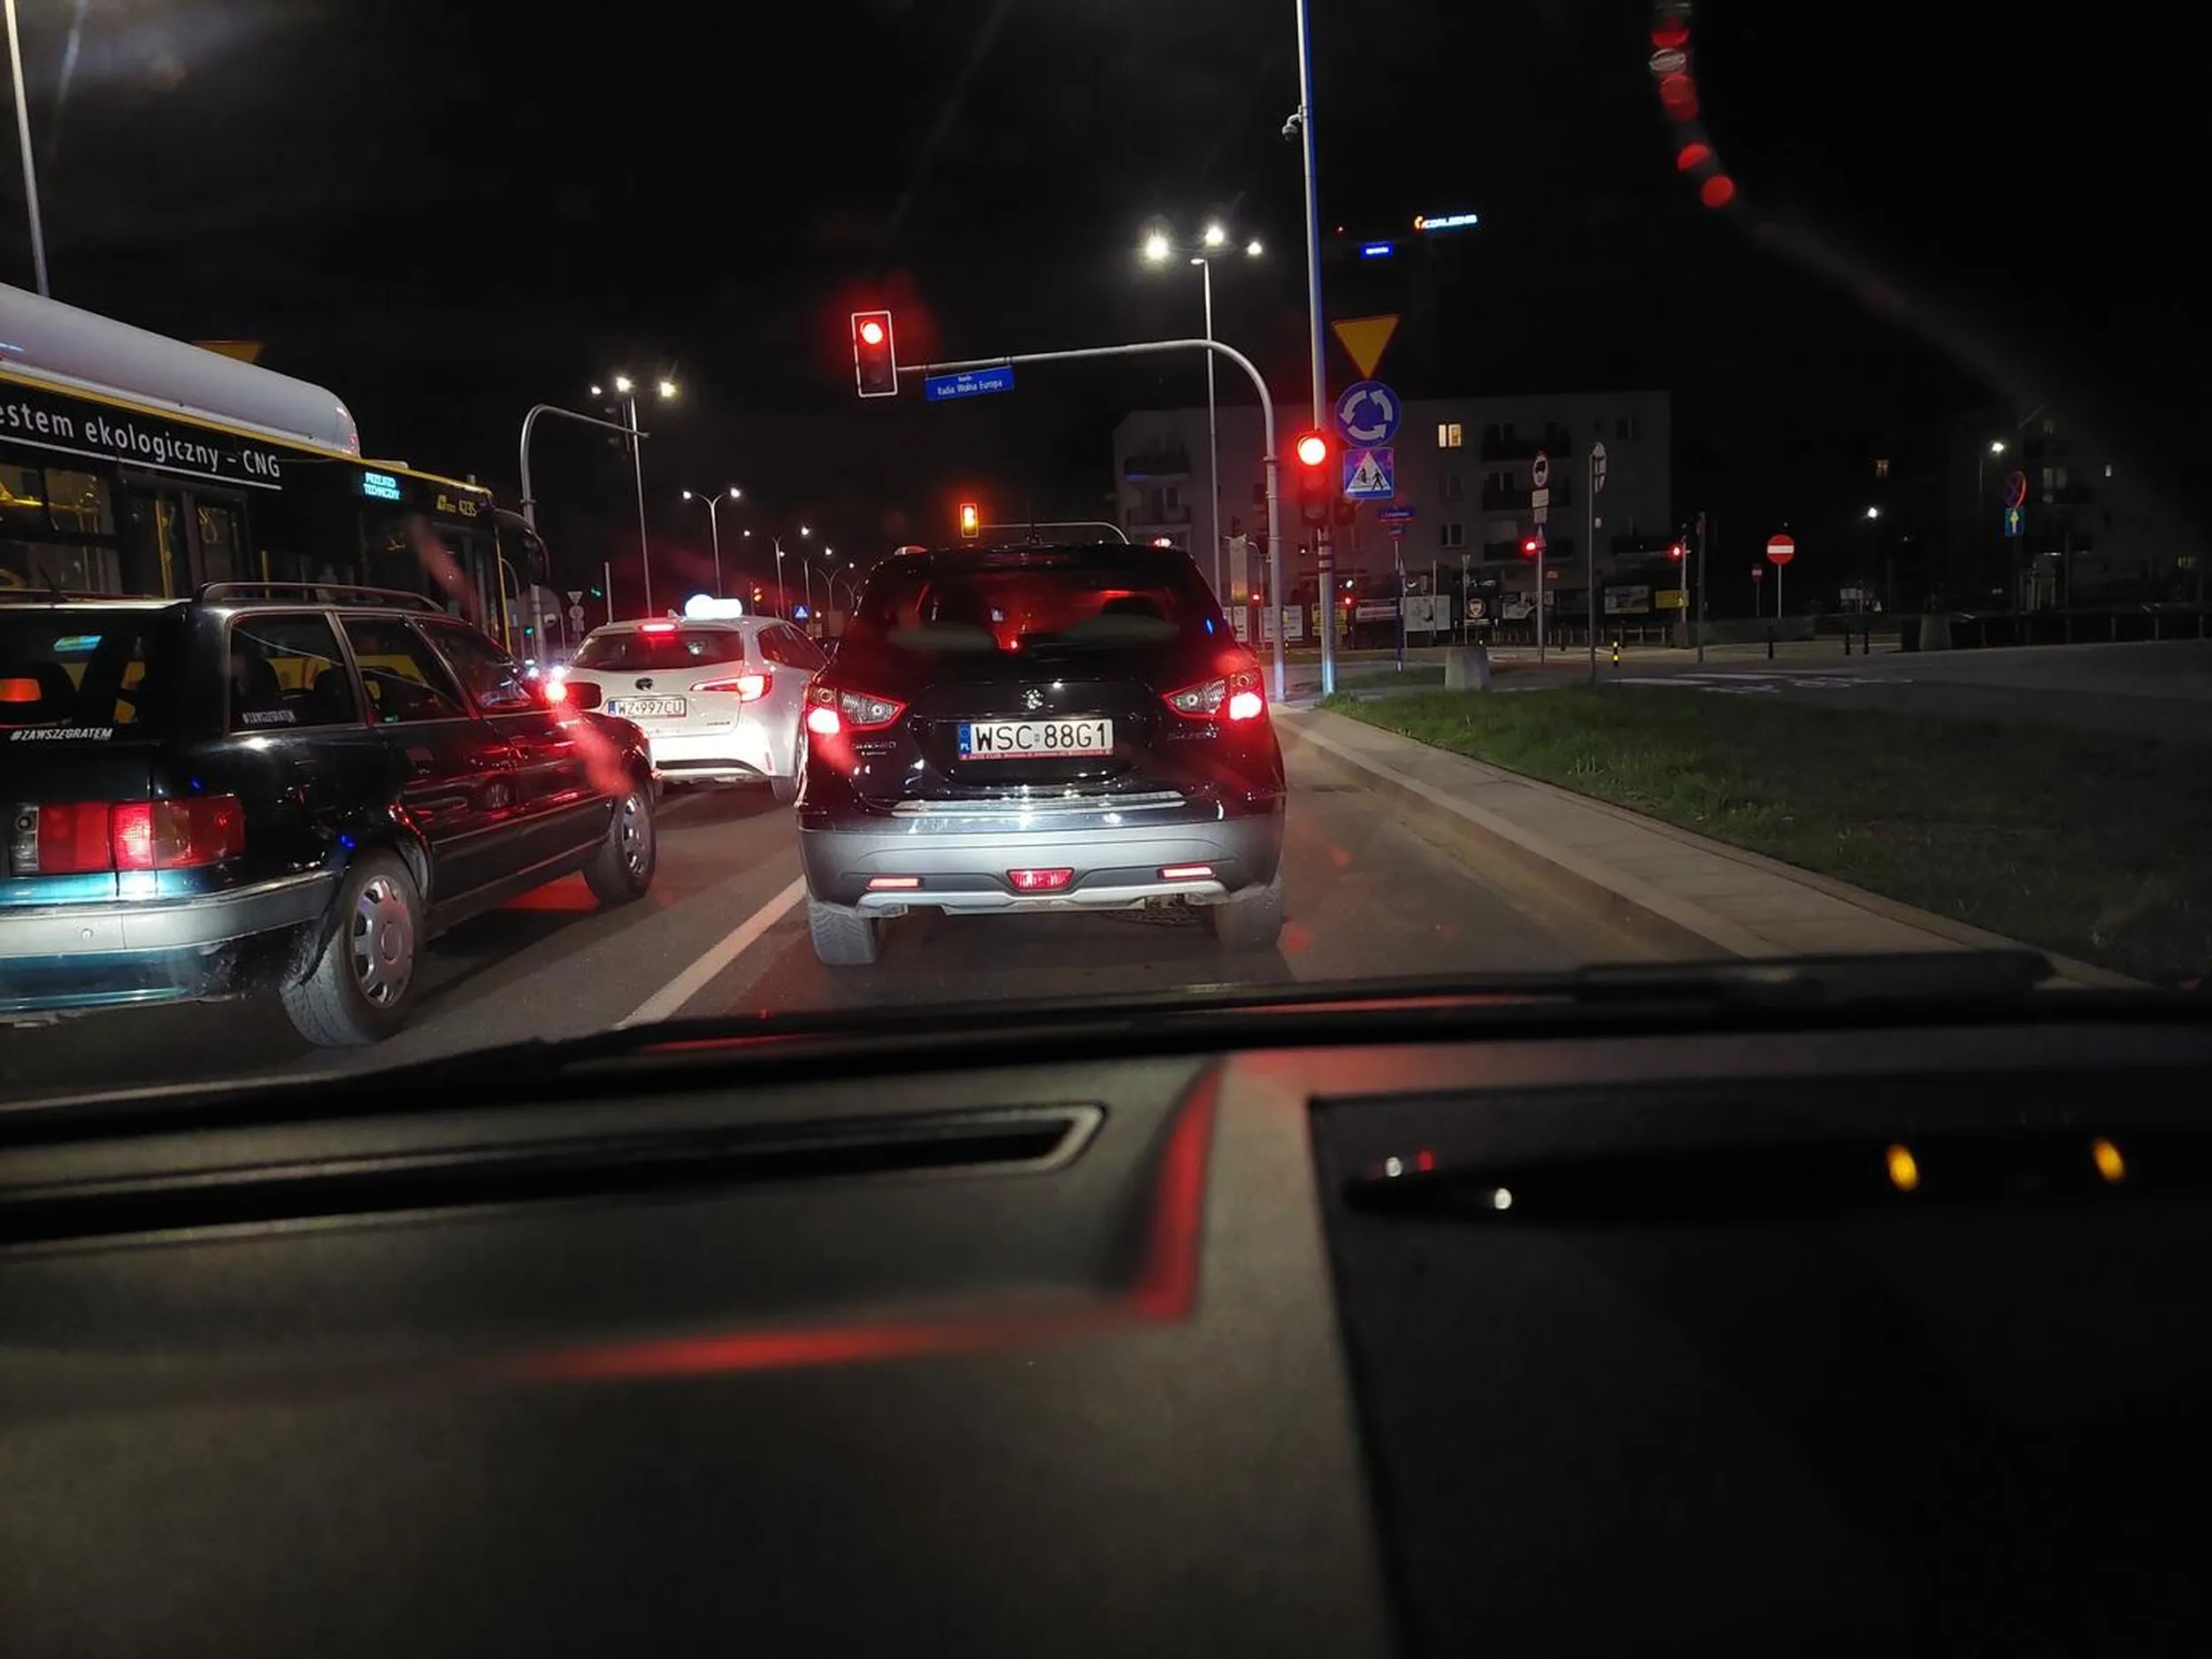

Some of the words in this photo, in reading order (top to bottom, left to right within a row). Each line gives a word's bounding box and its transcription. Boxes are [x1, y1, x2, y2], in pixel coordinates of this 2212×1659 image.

[979, 380, 1003, 390] Europa
[85, 416, 219, 472] ekologiczny
[242, 449, 281, 479] CNG
[640, 700, 682, 714] 997CU
[10, 727, 113, 741] #ZAWSZEGRATEM
[975, 726, 1033, 751] WSC
[1043, 723, 1105, 749] 88G1
